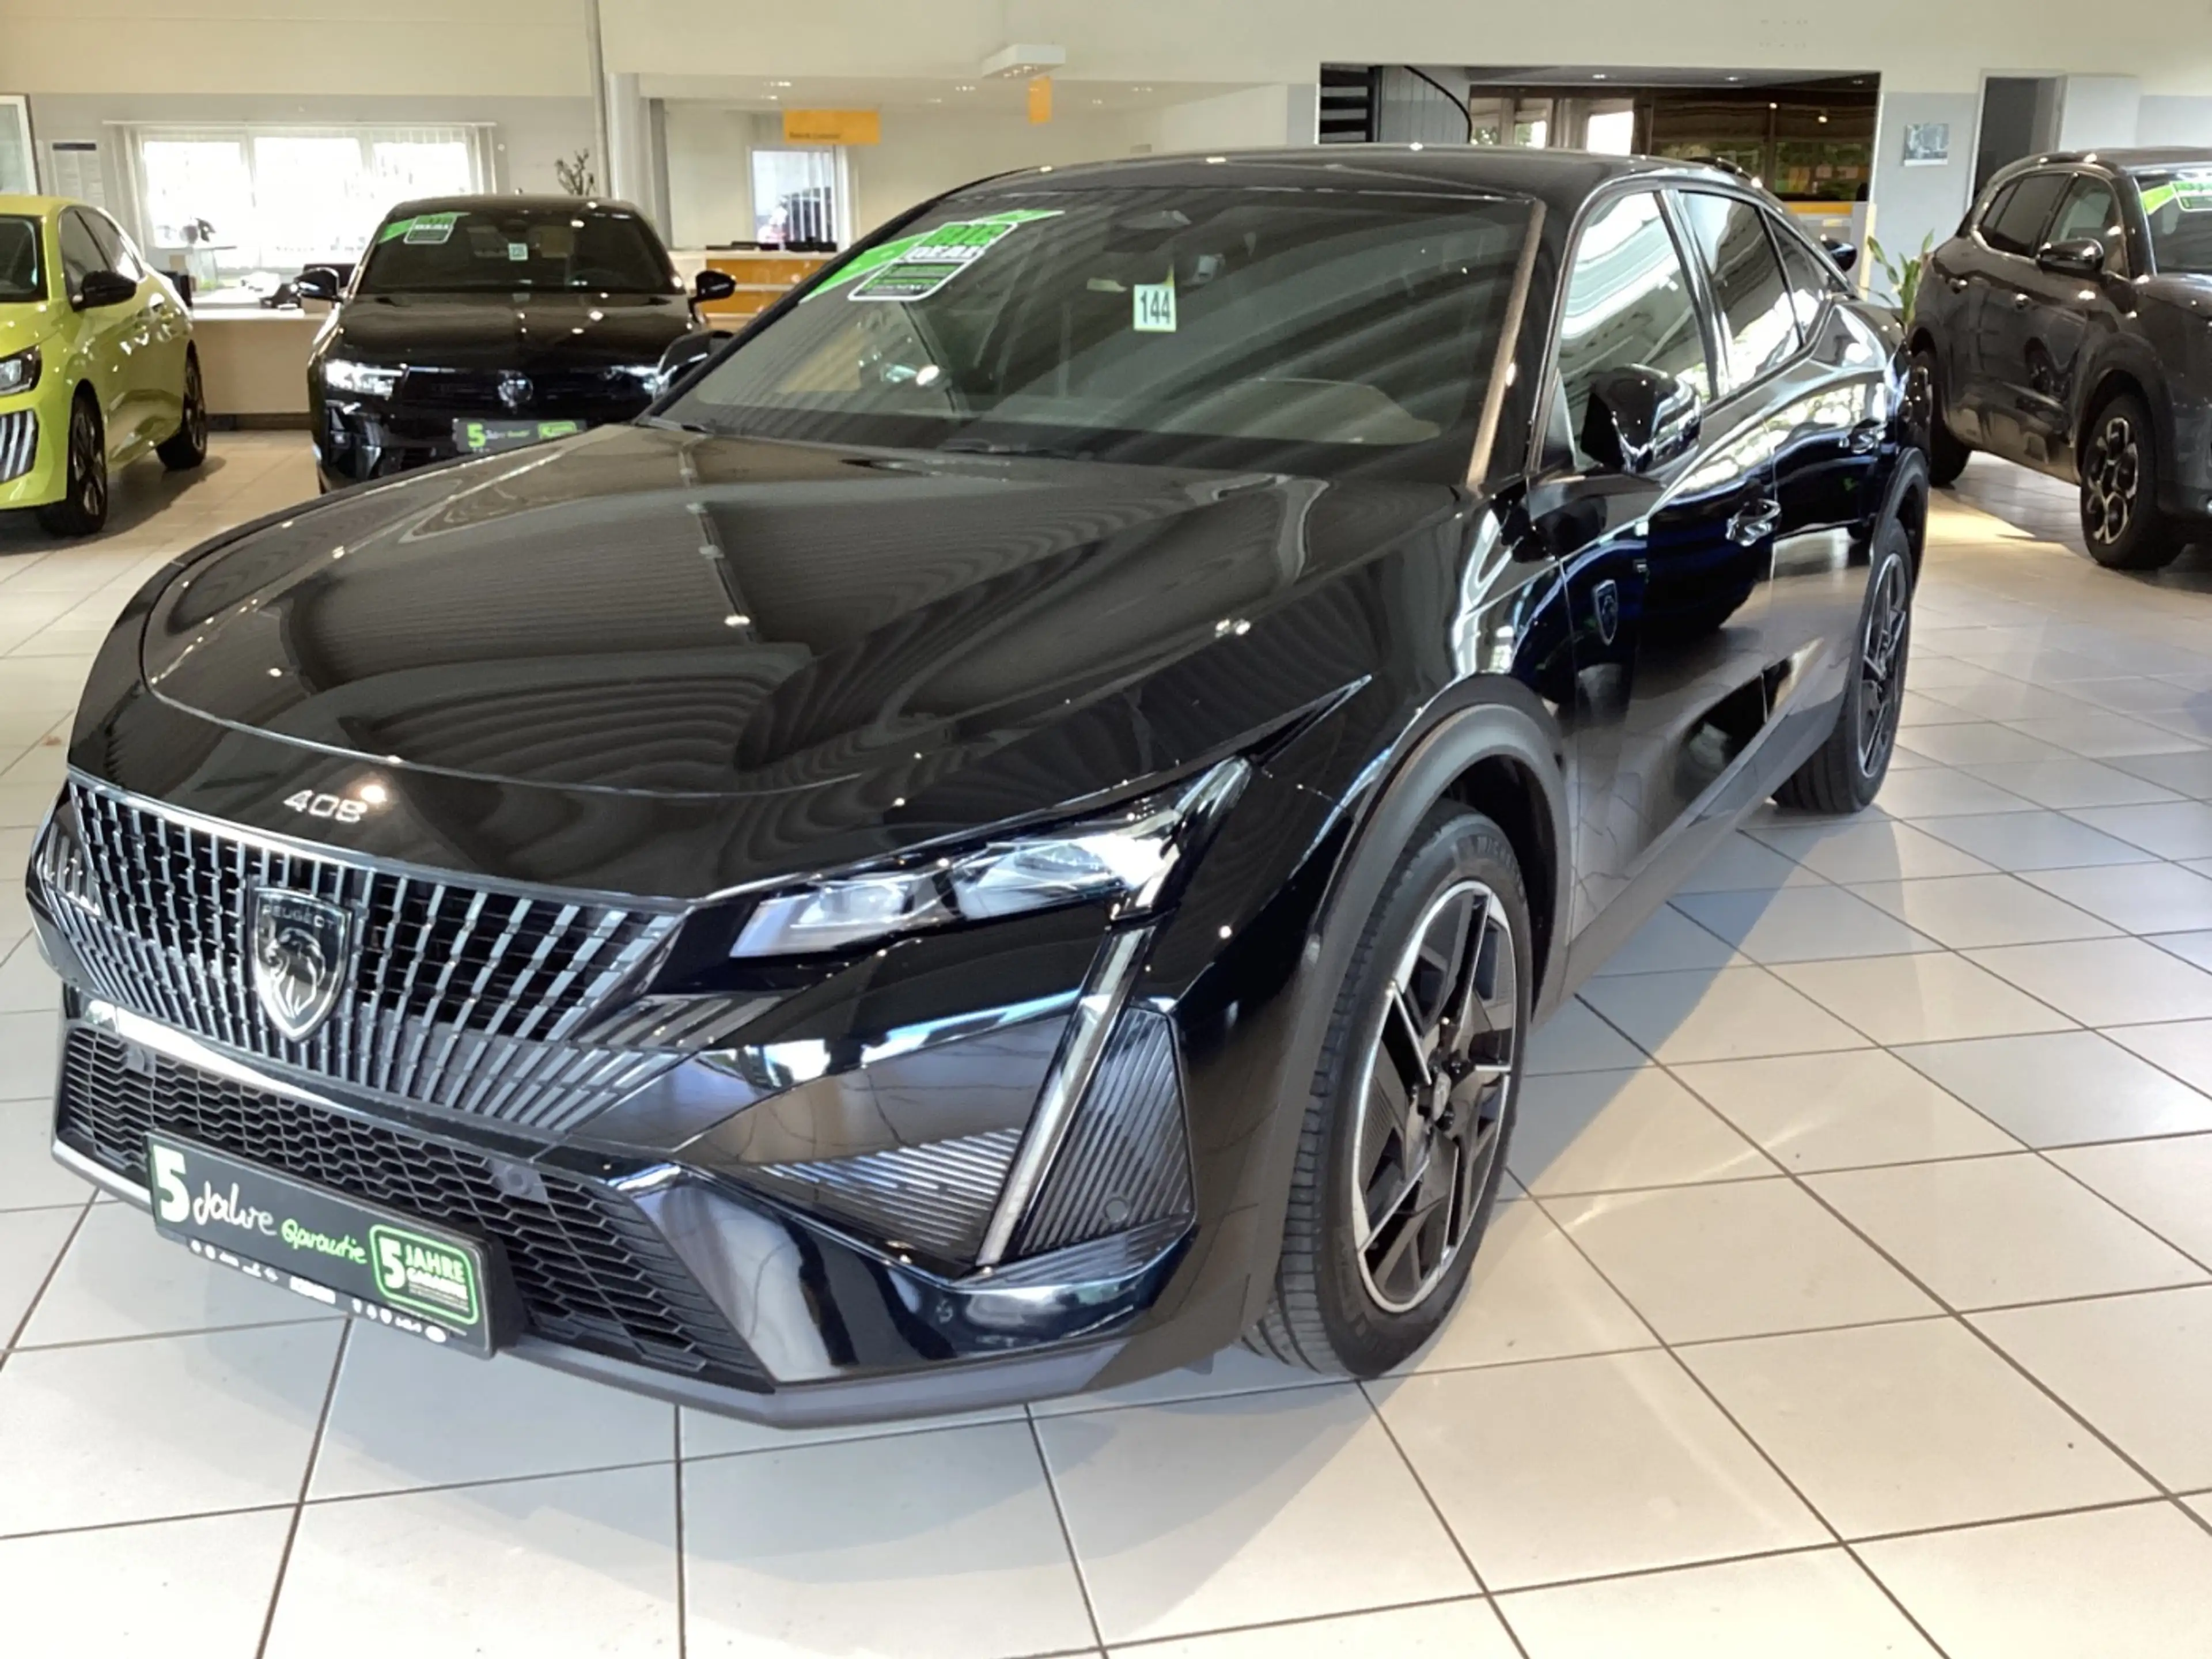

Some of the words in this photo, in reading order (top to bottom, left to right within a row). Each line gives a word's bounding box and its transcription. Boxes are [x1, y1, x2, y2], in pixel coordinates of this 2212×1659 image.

[1139, 290, 1171, 324] 144
[467, 423, 486, 448] 5
[283, 790, 368, 823] 408
[153, 1145, 190, 1222] 5
[378, 1236, 406, 1289] 5
[404, 1244, 466, 1285] JAHRE
